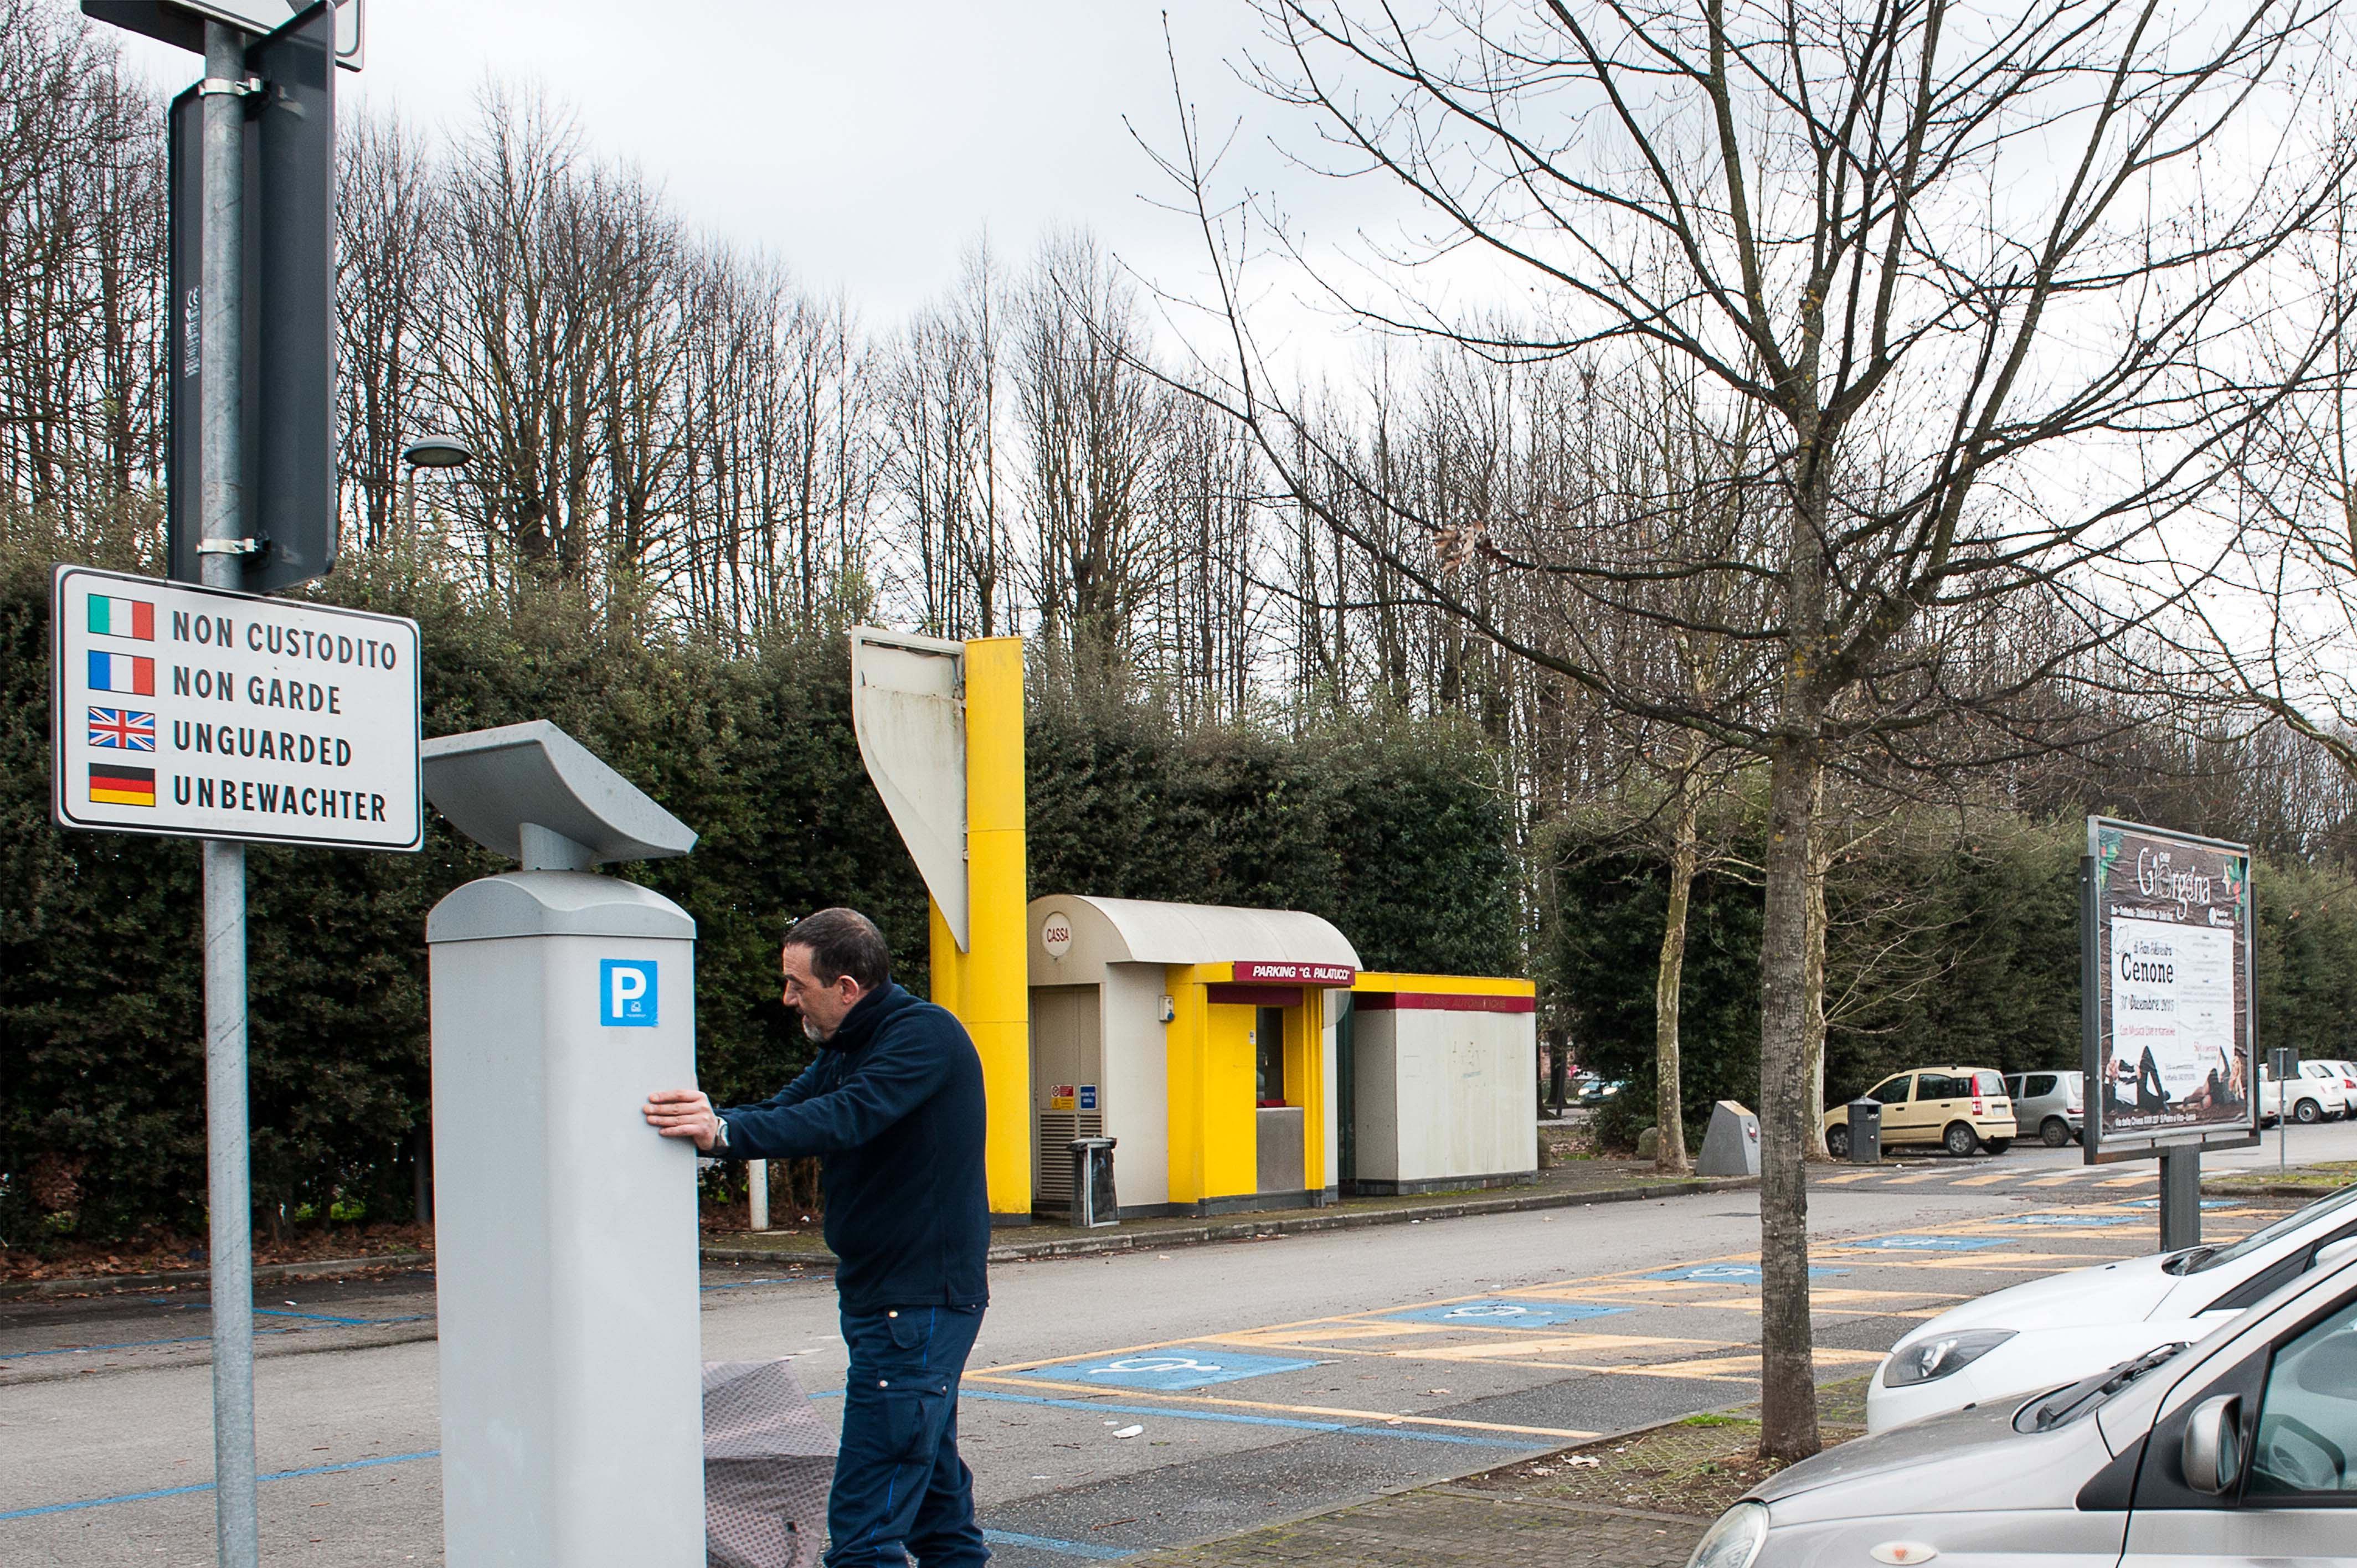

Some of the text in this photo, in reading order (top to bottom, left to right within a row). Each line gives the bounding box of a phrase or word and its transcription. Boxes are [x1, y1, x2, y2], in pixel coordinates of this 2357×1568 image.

[173, 611, 396, 670] NON CUSTODITO
[174, 666, 341, 715] NON GARDE
[174, 720, 352, 767] UNGUARDED
[175, 775, 386, 822] UNBEWACHTER
[1047, 927, 1069, 942] CASSA
[1252, 966, 1296, 978] PARKING
[2121, 952, 2173, 983] Cenone
[611, 967, 647, 1018] P
